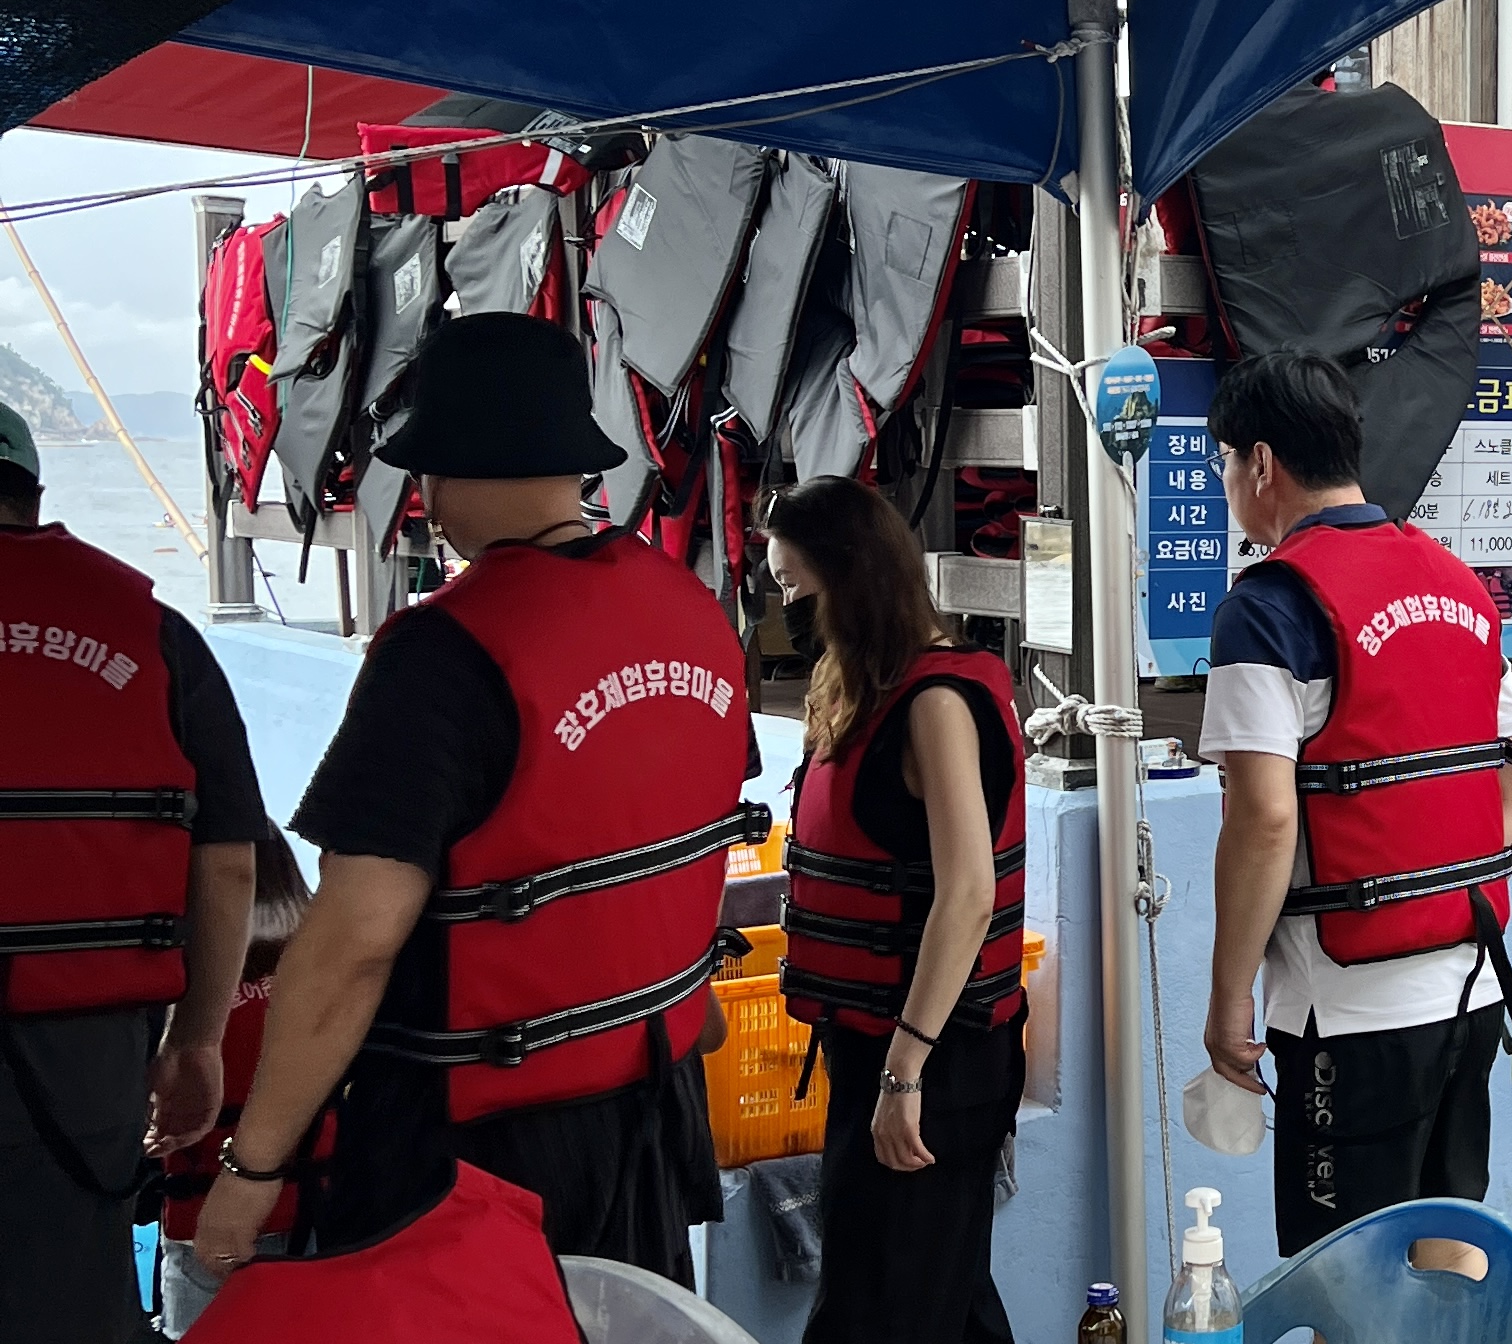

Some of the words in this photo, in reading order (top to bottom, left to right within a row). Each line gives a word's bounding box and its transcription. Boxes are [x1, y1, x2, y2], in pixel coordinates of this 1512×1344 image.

[1167, 434, 1208, 456] 장비
[1167, 469, 1209, 492] 내용
[1485, 469, 1512, 487] 세트
[1167, 505, 1208, 526] 시간
[1155, 538, 1221, 561] 요금(원)
[1167, 591, 1208, 613] 사진
[0, 620, 139, 690] 휴양마을
